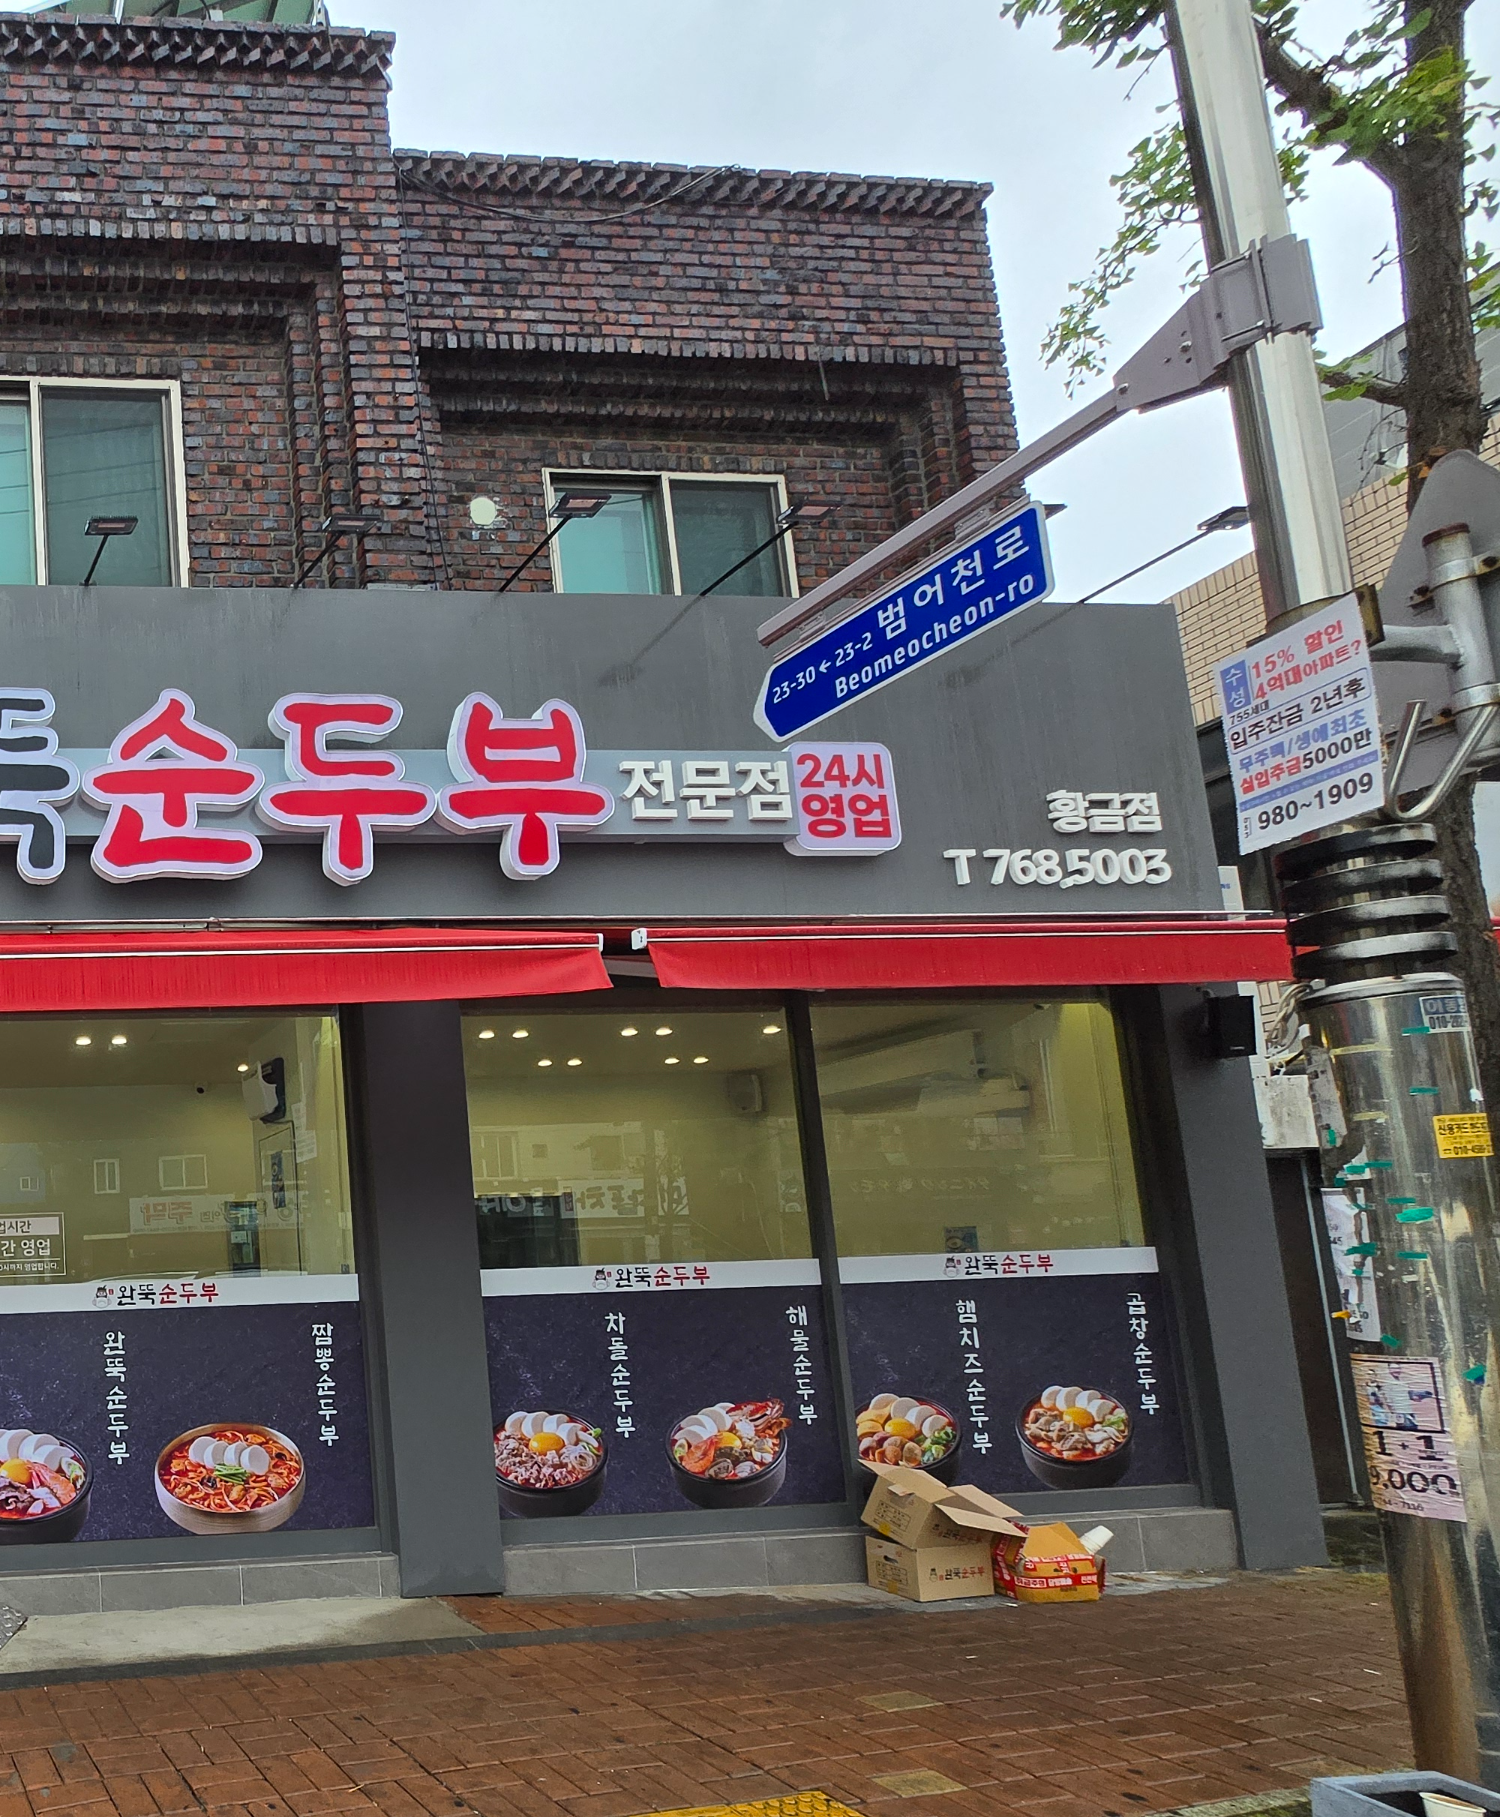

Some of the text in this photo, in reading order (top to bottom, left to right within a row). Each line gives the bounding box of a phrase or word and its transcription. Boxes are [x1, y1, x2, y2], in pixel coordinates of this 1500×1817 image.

[772, 526, 1029, 704] 23-30 23-2 범어천로
[834, 575, 1035, 699] Beomeocheon-ro
[1251, 619, 1345, 680] 15% 할인
[1254, 638, 1362, 701] 4억대아파트?
[1224, 667, 1246, 708] 수성
[1230, 676, 1367, 751] 입주잔금 2년후
[618, 759, 793, 822] 전문점
[796, 752, 886, 790] 24시
[1239, 727, 1373, 795] 실입주금5000만
[800, 792, 893, 839] 영업
[1046, 789, 1164, 834] 황금점
[1257, 772, 1374, 831] 980~1909
[942, 848, 977, 886] T
[20, 1238, 51, 1257] 영업
[614, 1265, 711, 1288] 완뚝순두부
[964, 1254, 1054, 1276] 완뚝순두부
[115, 1282, 220, 1306] 완뚝순두부
[310, 1322, 340, 1448] 짬뽕순두부
[603, 1311, 637, 1439] 차돌순두부
[785, 1304, 818, 1426] 해물순두부
[955, 1299, 993, 1455] 햄치즈순두부
[1126, 1292, 1160, 1416] 곱창순두부
[103, 1330, 131, 1466] 완뚝순두부
